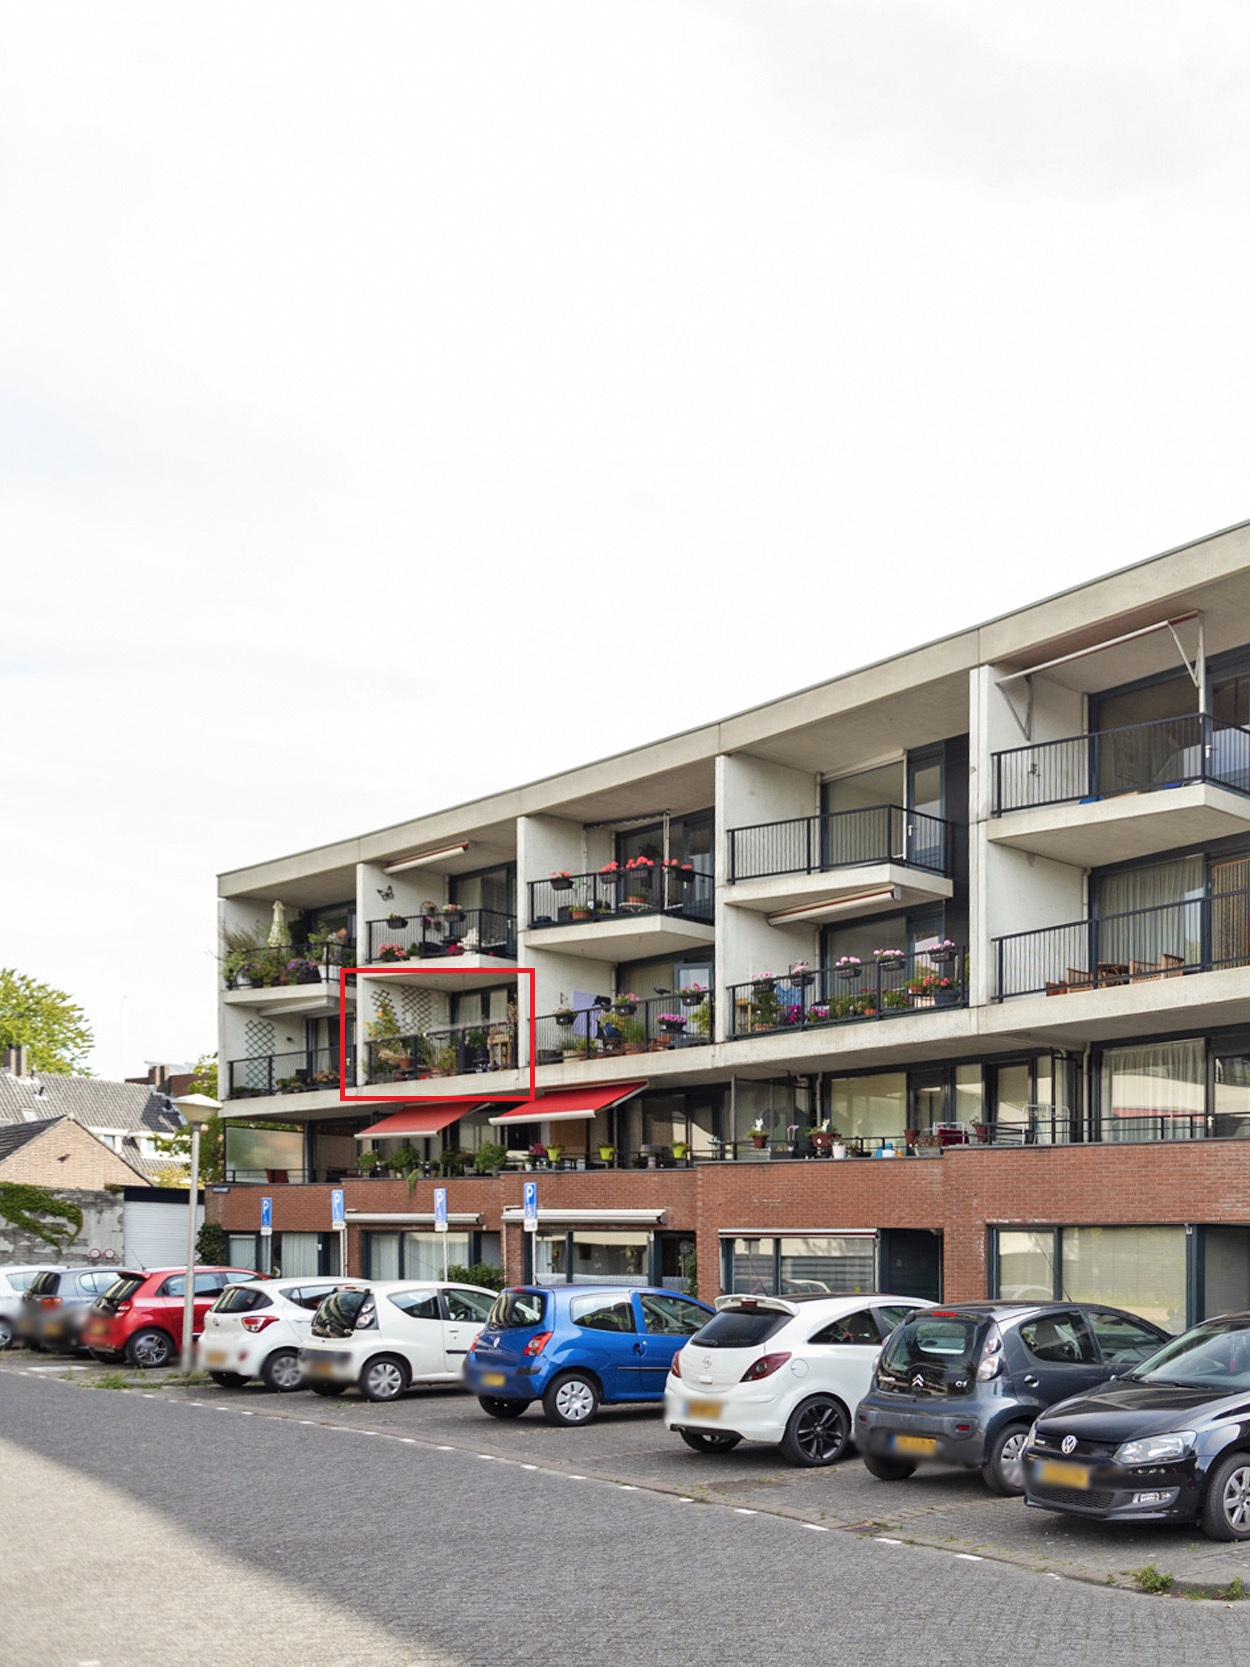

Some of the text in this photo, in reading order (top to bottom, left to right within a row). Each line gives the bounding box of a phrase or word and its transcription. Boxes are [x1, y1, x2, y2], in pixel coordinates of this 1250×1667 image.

[334, 1193, 341, 1208] P
[436, 1191, 443, 1208] P
[526, 1185, 533, 1204] P
[263, 1200, 269, 1215] P
